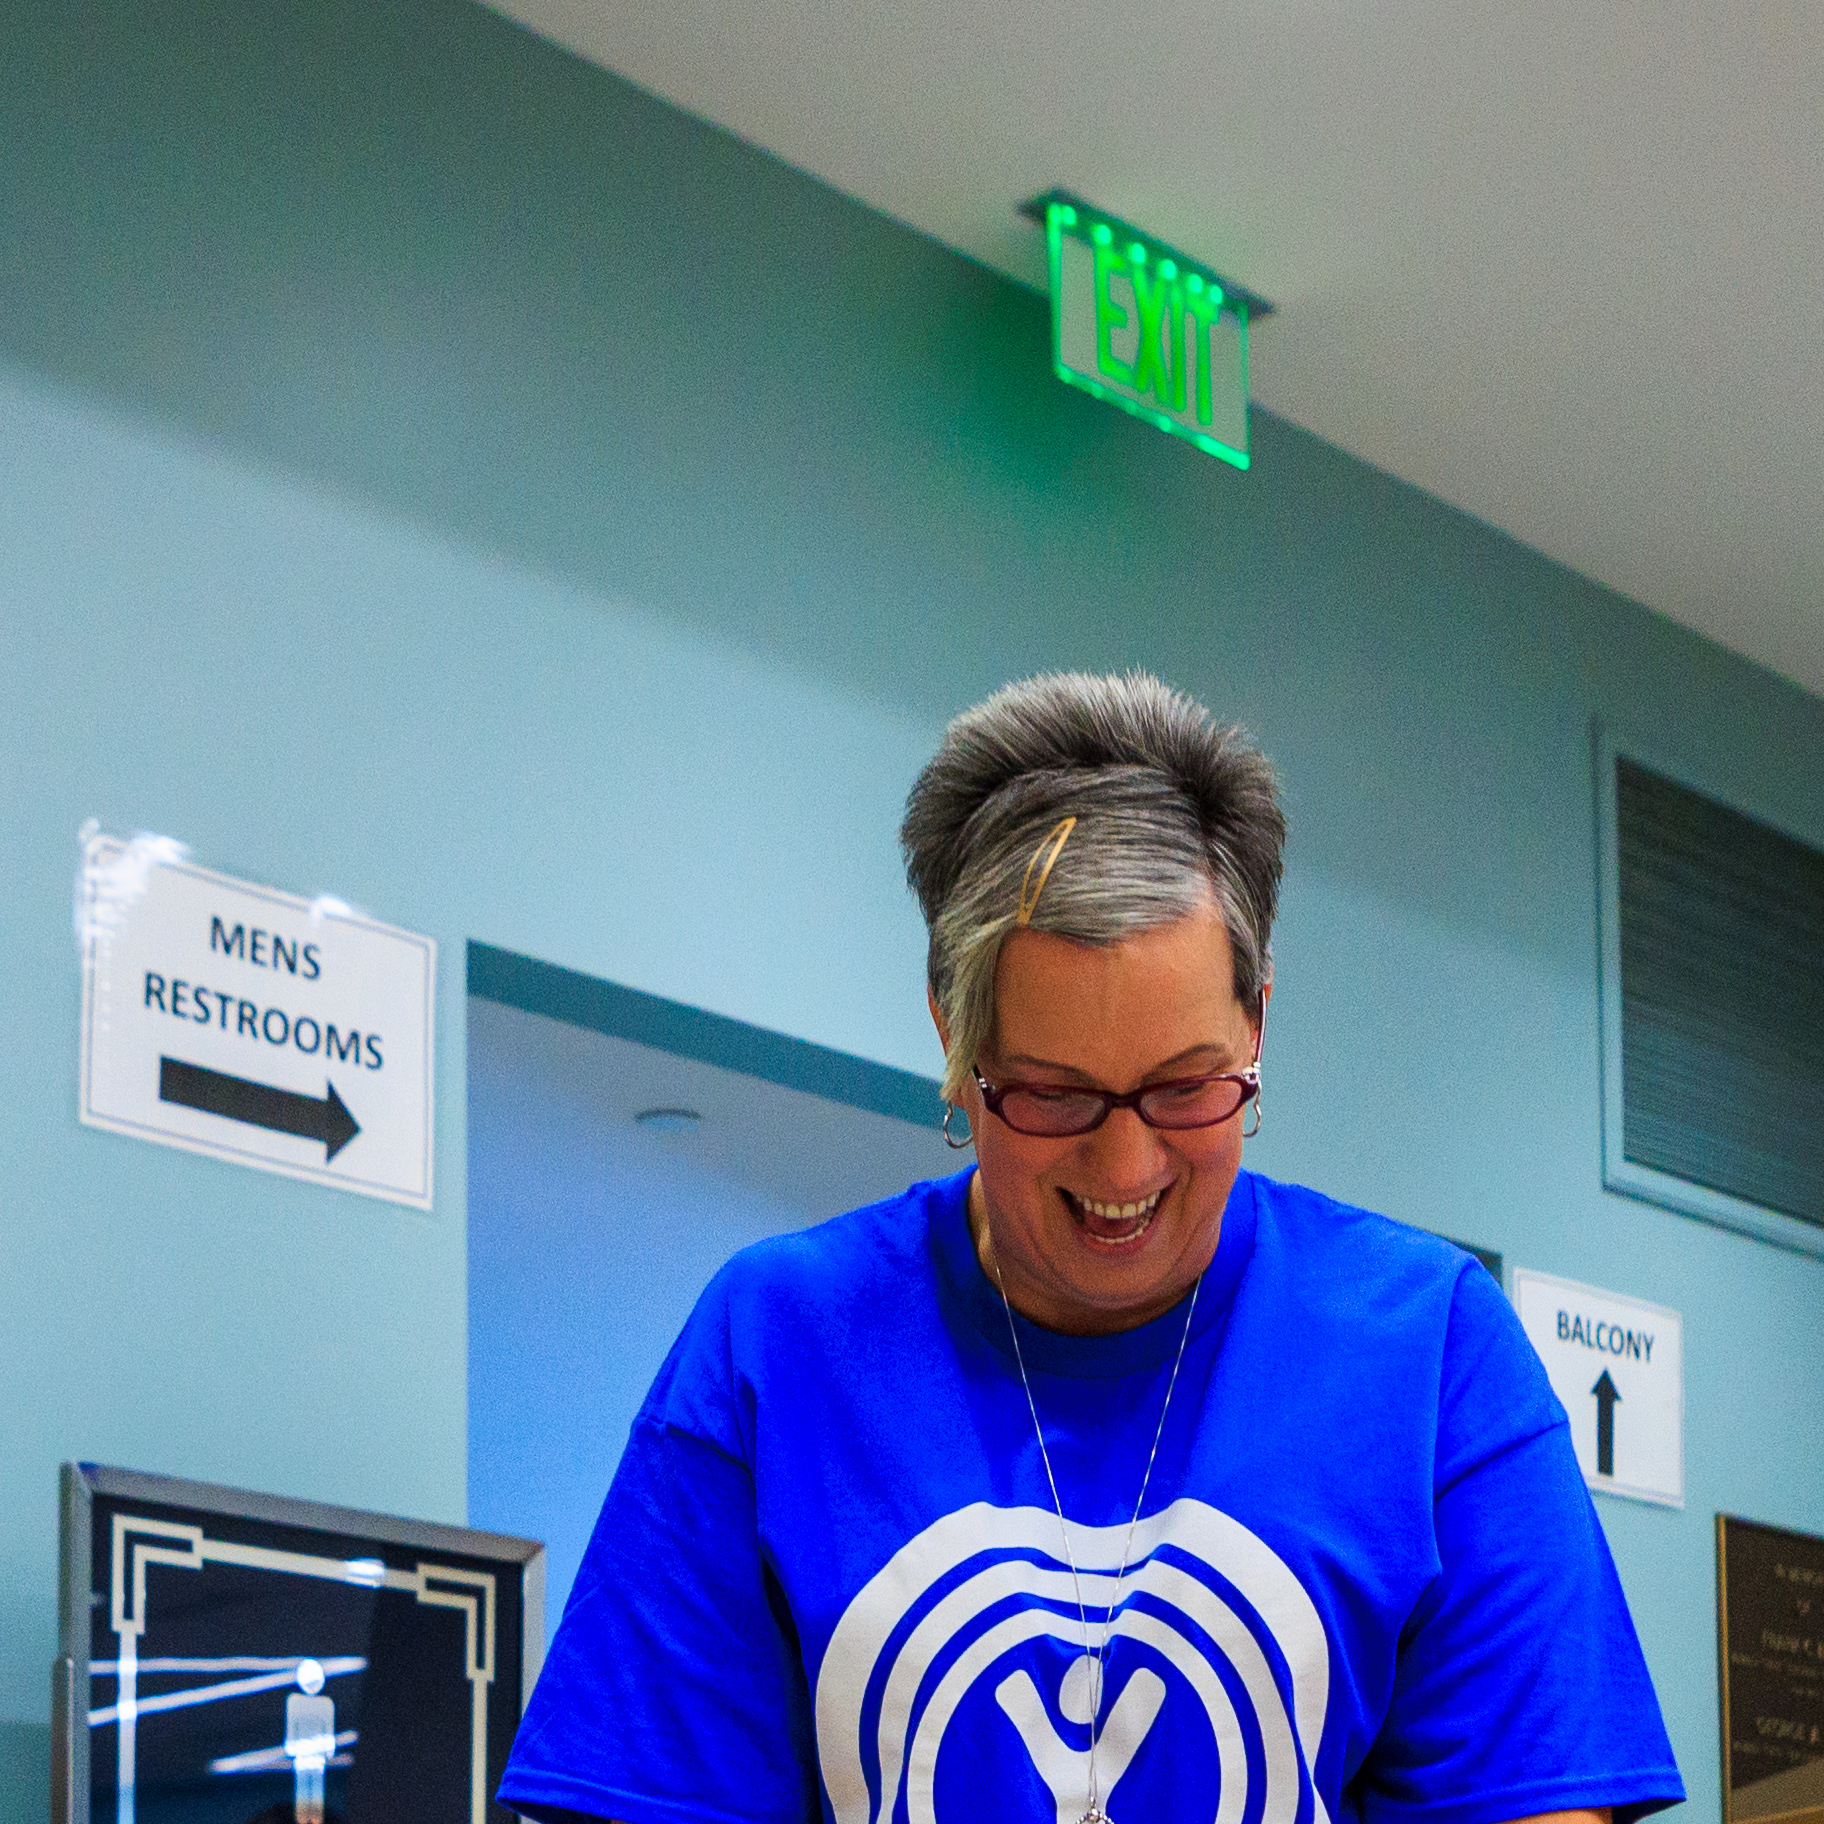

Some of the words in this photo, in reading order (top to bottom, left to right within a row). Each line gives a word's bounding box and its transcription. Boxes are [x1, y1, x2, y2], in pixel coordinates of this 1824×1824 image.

[1093, 245, 1221, 427] EXIT
[209, 915, 323, 982] MENS
[143, 972, 386, 1072] RESTROOMS
[1556, 1310, 1656, 1363] BALCONY
